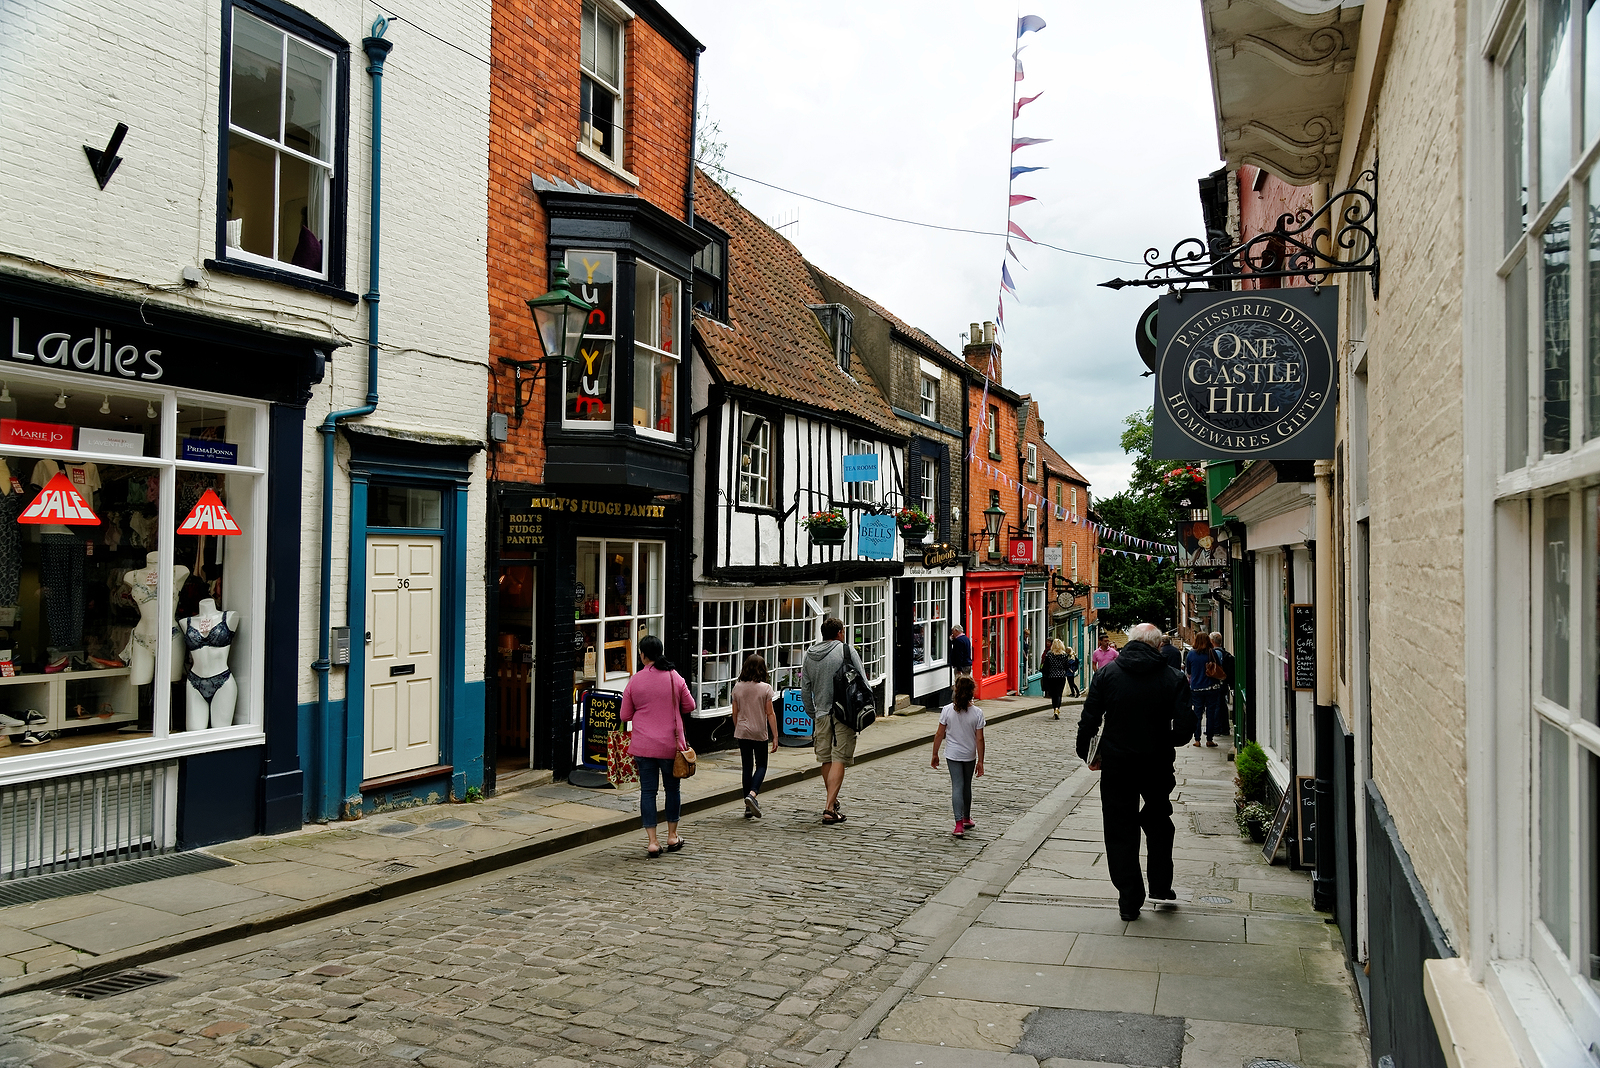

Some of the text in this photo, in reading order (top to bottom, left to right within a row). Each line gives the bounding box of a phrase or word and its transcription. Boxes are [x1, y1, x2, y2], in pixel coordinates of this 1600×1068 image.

[1176, 303, 1317, 349] PATISSERIE DELI
[11, 317, 164, 380] Ladies
[1213, 332, 1277, 360] ONE
[1188, 358, 1301, 386] CASTLE
[575, 348, 605, 414] Yum
[1206, 386, 1280, 415] HILL
[1167, 390, 1322, 448] HOMEWARES GIFTS
[10, 427, 48, 439] MARIE
[49, 431, 63, 443] JO
[88, 439, 135, 449] L'AVENTURE
[186, 444, 234, 456] PRIMADONNA
[23, 490, 97, 520] SALE
[581, 500, 622, 516] FUDGE
[623, 504, 666, 518] PANTRY
[180, 504, 240, 531] SALE
[509, 514, 543, 523] ROLY'S
[509, 525, 543, 534] FUDGE
[506, 536, 545, 544] PANTRY
[925, 550, 956, 566] Cahoots
[397, 578, 410, 589] 36
[591, 698, 616, 709] Roly's
[789, 692, 802, 702] TE
[590, 708, 616, 720] Fudge
[785, 703, 806, 713] ROO
[589, 718, 617, 730] Pantry
[784, 717, 812, 727] OPEN
